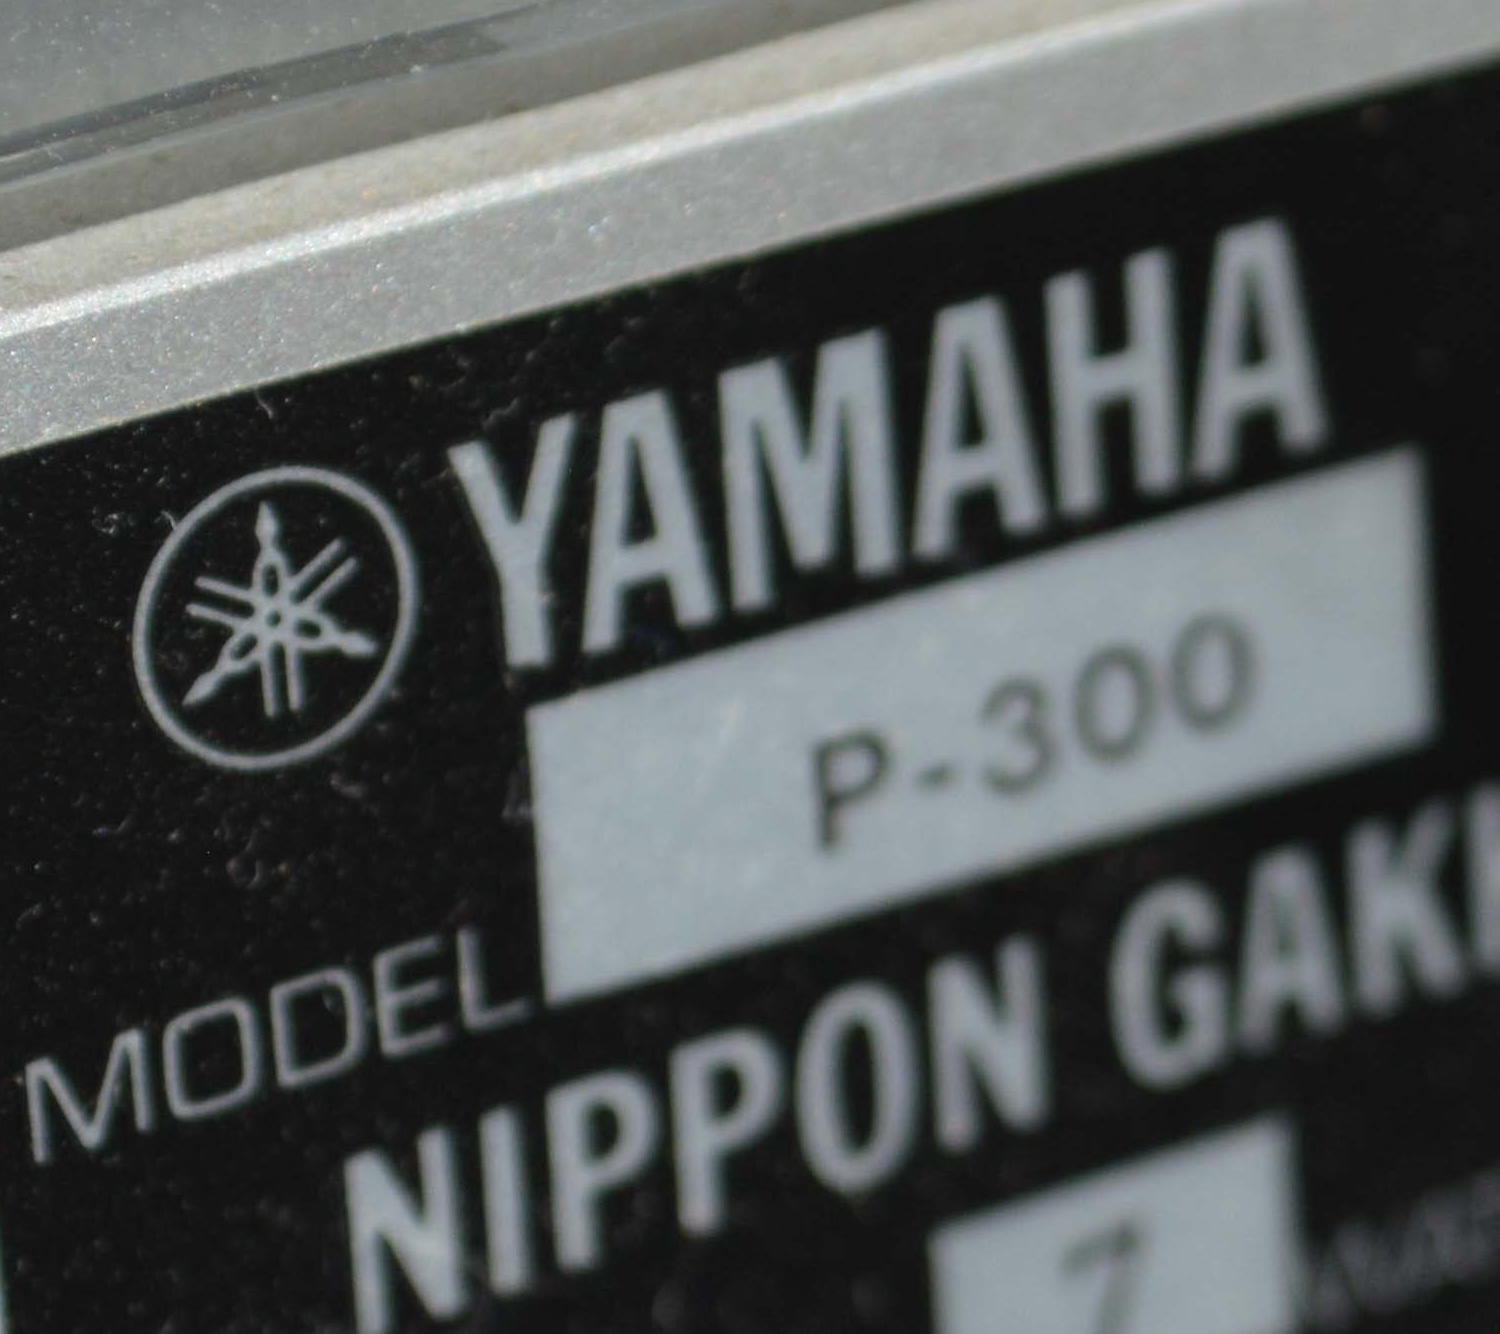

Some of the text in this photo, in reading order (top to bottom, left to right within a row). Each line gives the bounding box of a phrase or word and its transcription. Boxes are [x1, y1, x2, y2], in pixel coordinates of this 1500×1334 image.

[446, 216, 1332, 671] YAMAHA
[22, 610, 1260, 1167] MODEL P-300
